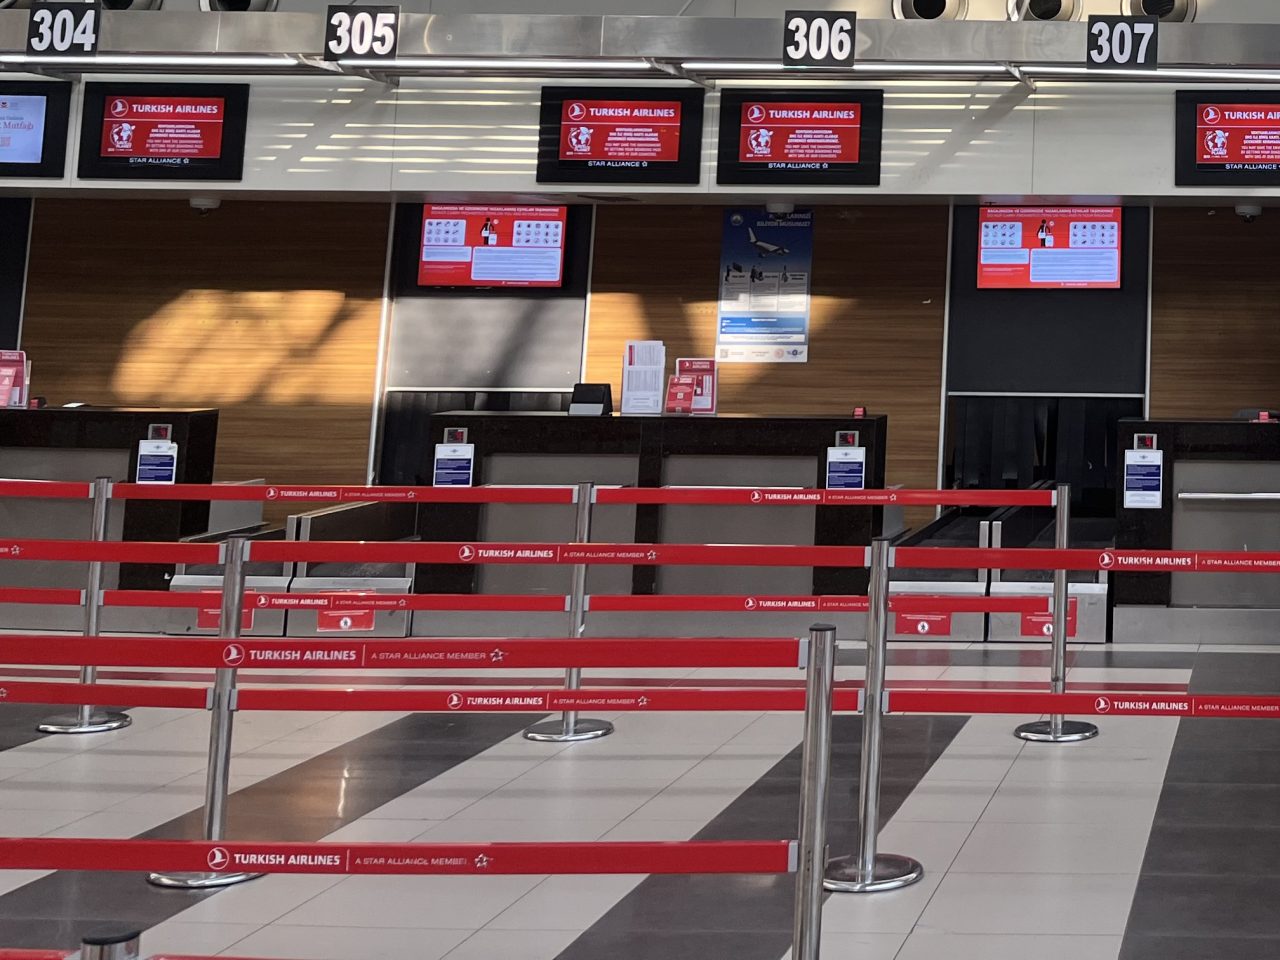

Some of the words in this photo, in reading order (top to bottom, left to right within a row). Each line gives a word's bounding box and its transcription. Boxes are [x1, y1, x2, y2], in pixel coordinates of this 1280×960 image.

[30, 9, 96, 52] 304
[328, 12, 396, 55] 305
[785, 17, 852, 61] 306
[1089, 22, 1154, 64] 307
[131, 104, 173, 113] TURKISH
[175, 105, 218, 114] AIRLINES
[589, 107, 631, 116] TURKISH
[632, 108, 675, 117] AIRLINES
[769, 110, 810, 118] TURKISH
[812, 110, 854, 119] AIRLINES
[1224, 111, 1265, 120] TURKISH
[309, 490, 337, 498] AIRLINES
[478, 549, 514, 557] TURKISH
[516, 549, 553, 558] AIRLINES
[1117, 556, 1153, 564] TURKISH
[1154, 557, 1191, 566] AIRLINES
[299, 598, 328, 606] AIRLINES
[249, 649, 300, 660] TURKISH
[303, 650, 356, 661] AIRLINES
[371, 652, 378, 660] A
[378, 652, 401, 660] STAR
[403, 652, 445, 660] ALLIANCE
[446, 652, 486, 660] MEMBER
[467, 697, 503, 705] TURKISH
[504, 697, 543, 705] AIRLINES
[1113, 701, 1149, 709] TURKISH
[1151, 702, 1188, 711] AIRLINES
[234, 853, 285, 865] TURKISH
[287, 854, 340, 865] AIRLINES
[355, 857, 362, 865] A
[362, 857, 385, 865] STAR
